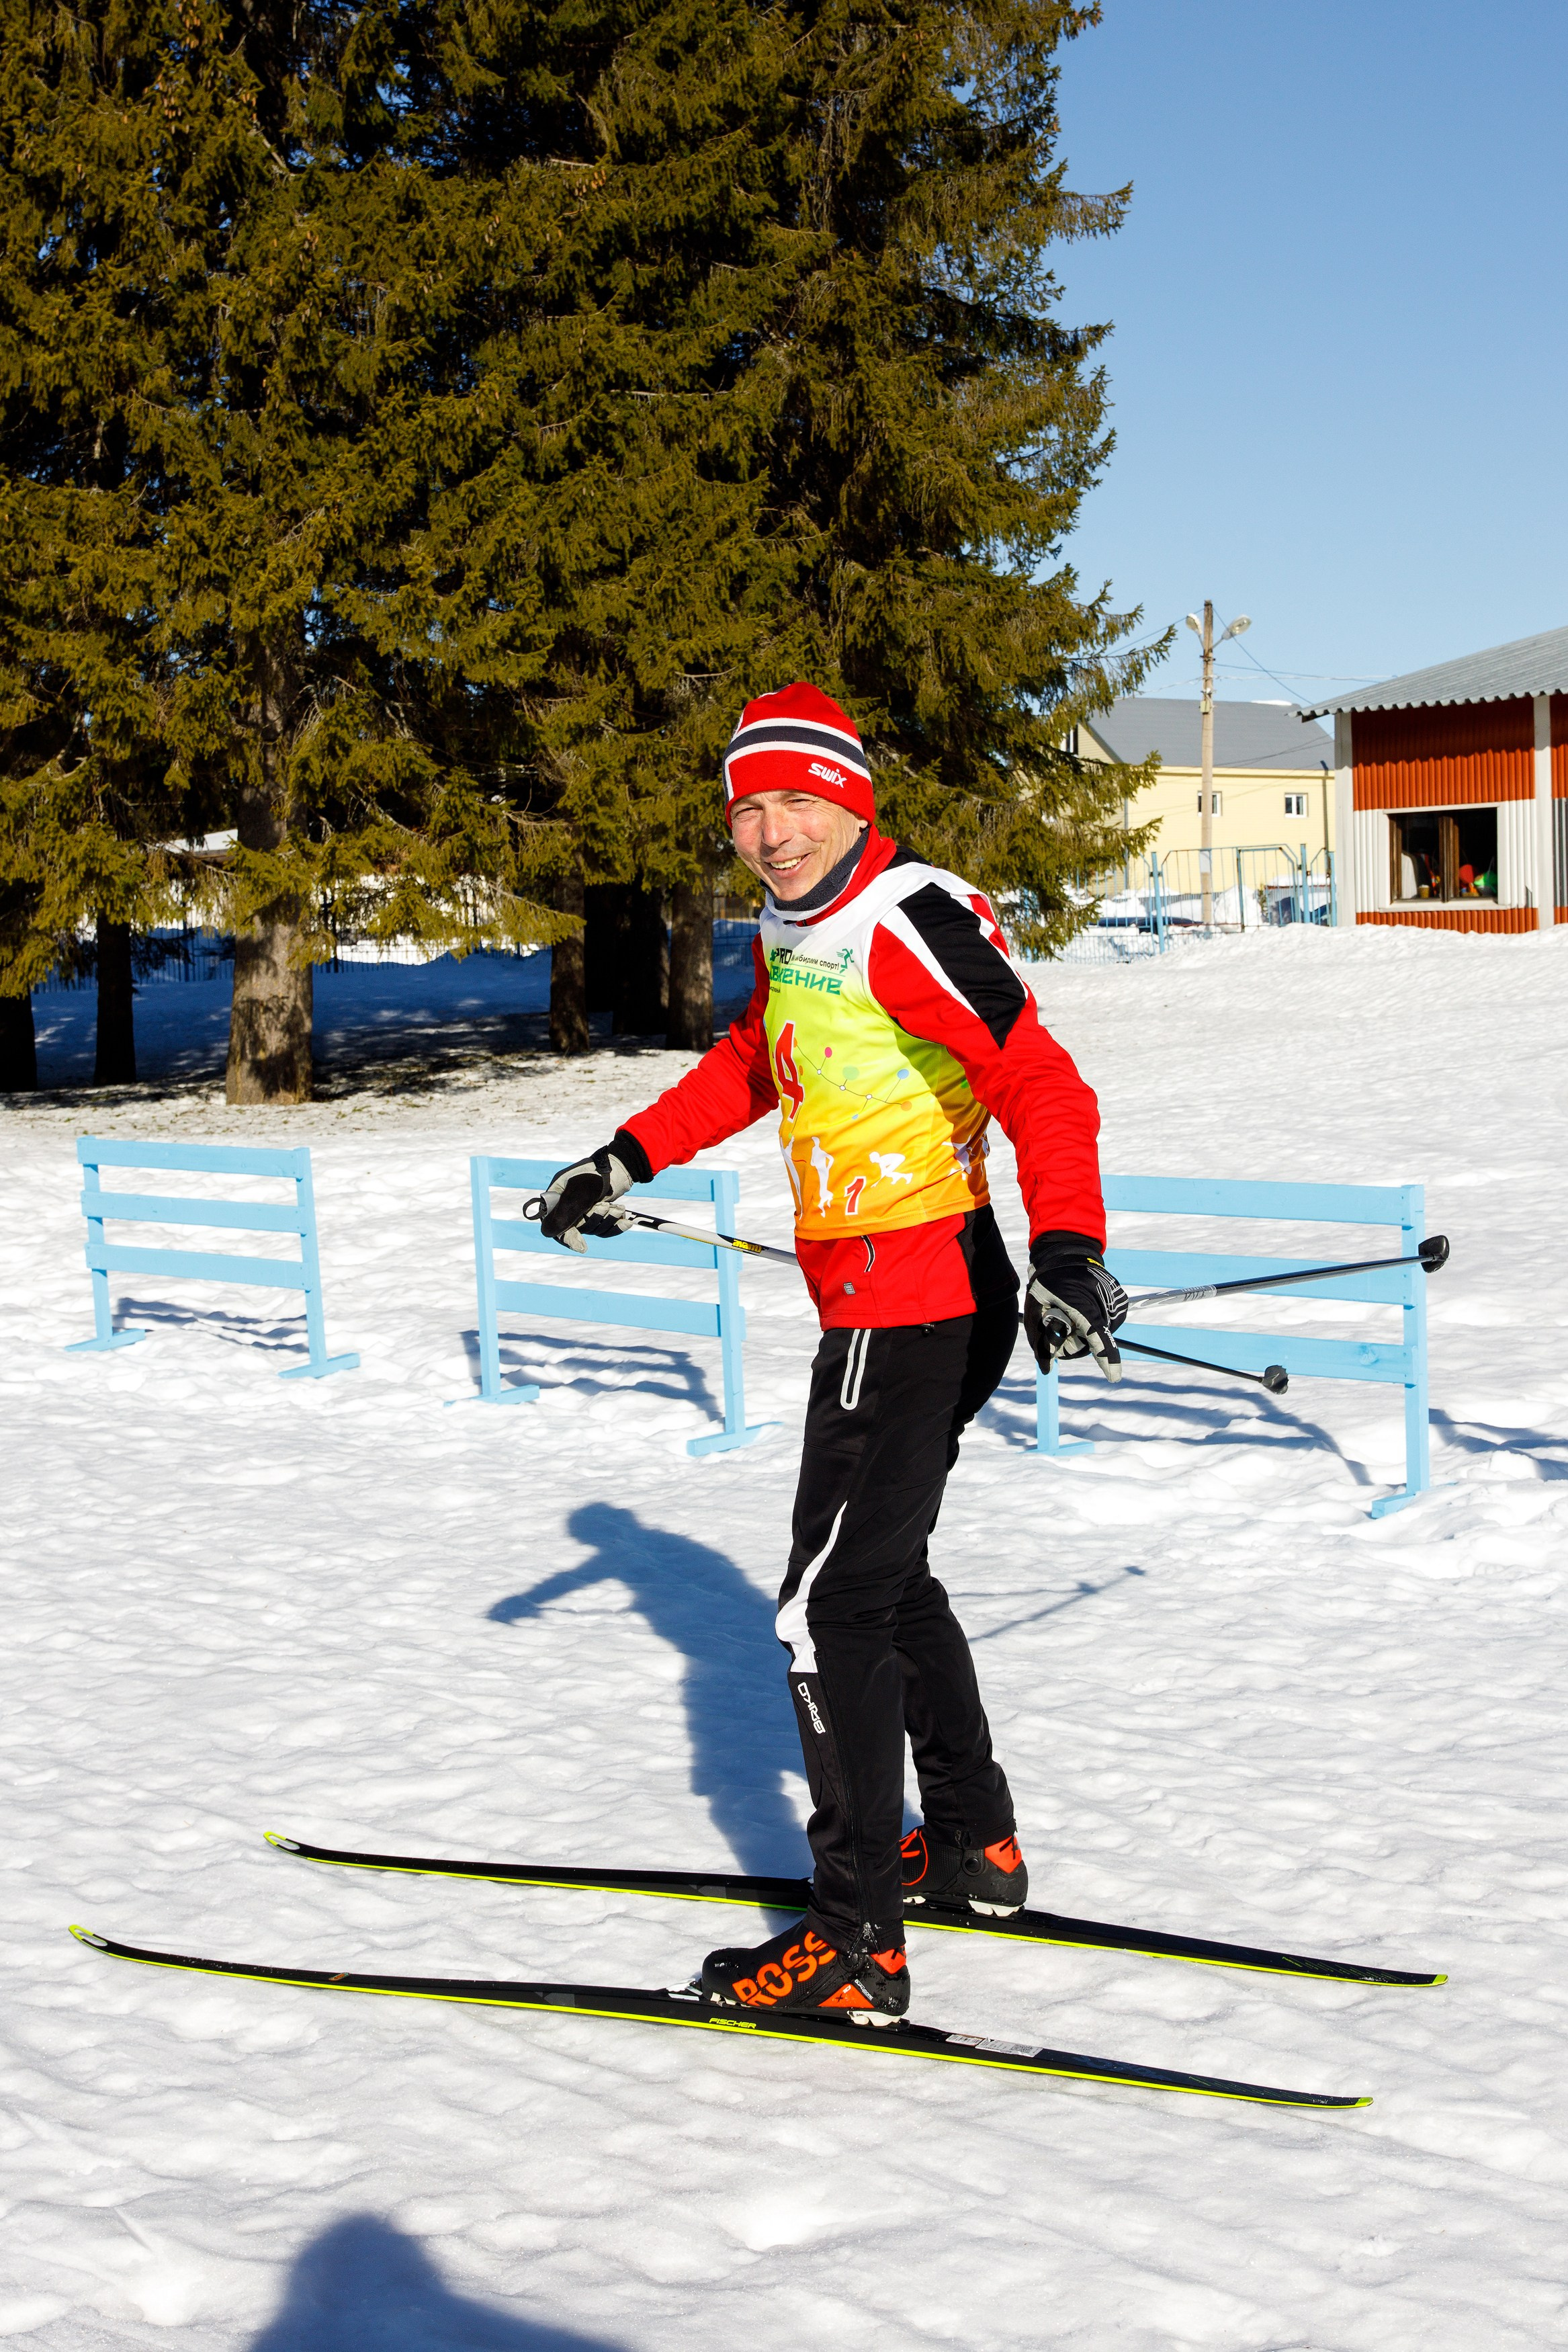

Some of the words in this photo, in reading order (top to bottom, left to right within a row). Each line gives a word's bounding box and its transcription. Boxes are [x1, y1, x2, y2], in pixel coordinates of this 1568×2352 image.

[819, 960, 840, 970] спорт!
[775, 1020, 805, 1123] 4
[844, 1176, 867, 1216] 1
[797, 1681, 826, 1734] BRIKO
[709, 2017, 757, 2029] FISCHER
